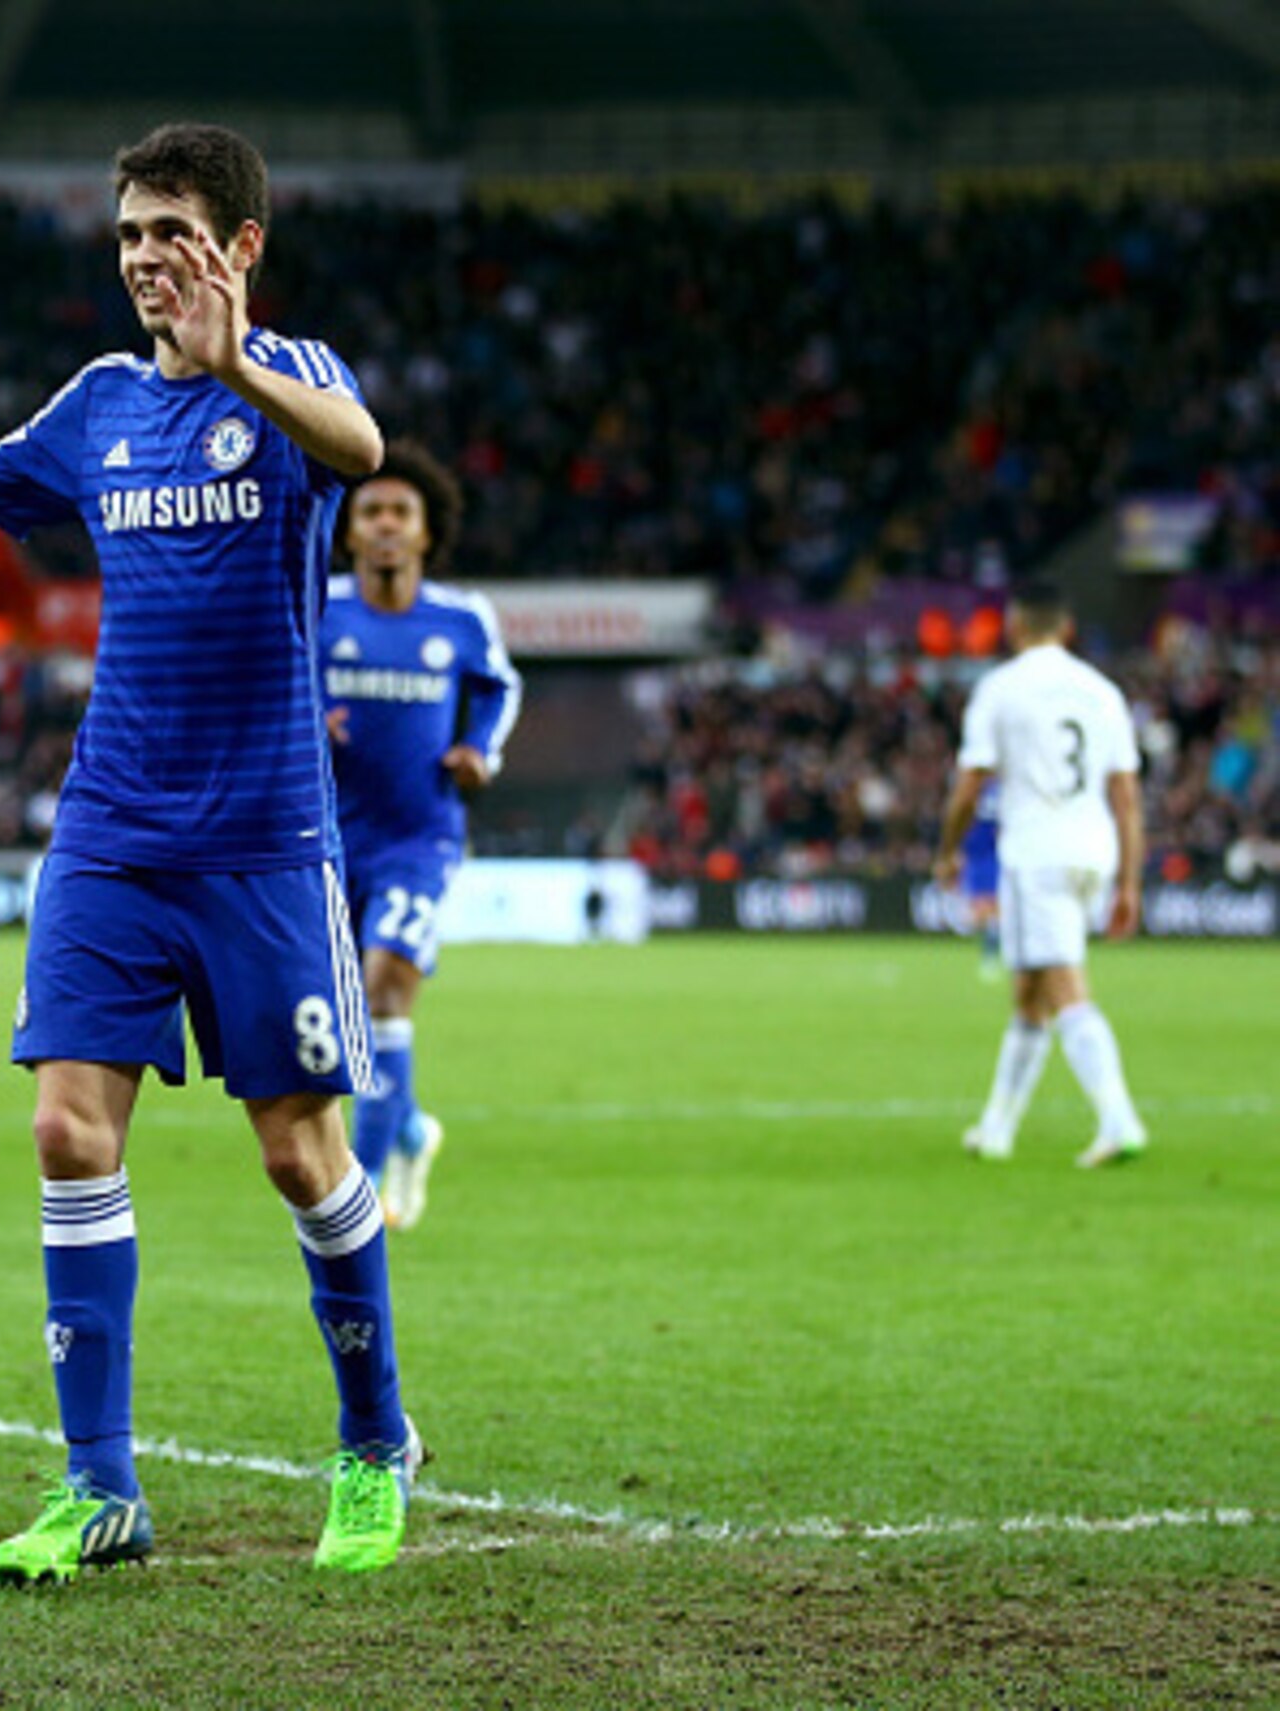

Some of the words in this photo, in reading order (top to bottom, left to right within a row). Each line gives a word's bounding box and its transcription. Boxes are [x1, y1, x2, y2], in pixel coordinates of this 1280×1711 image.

[1058, 717, 1086, 797] 3
[376, 885, 437, 947] 22
[292, 995, 341, 1075] 8
